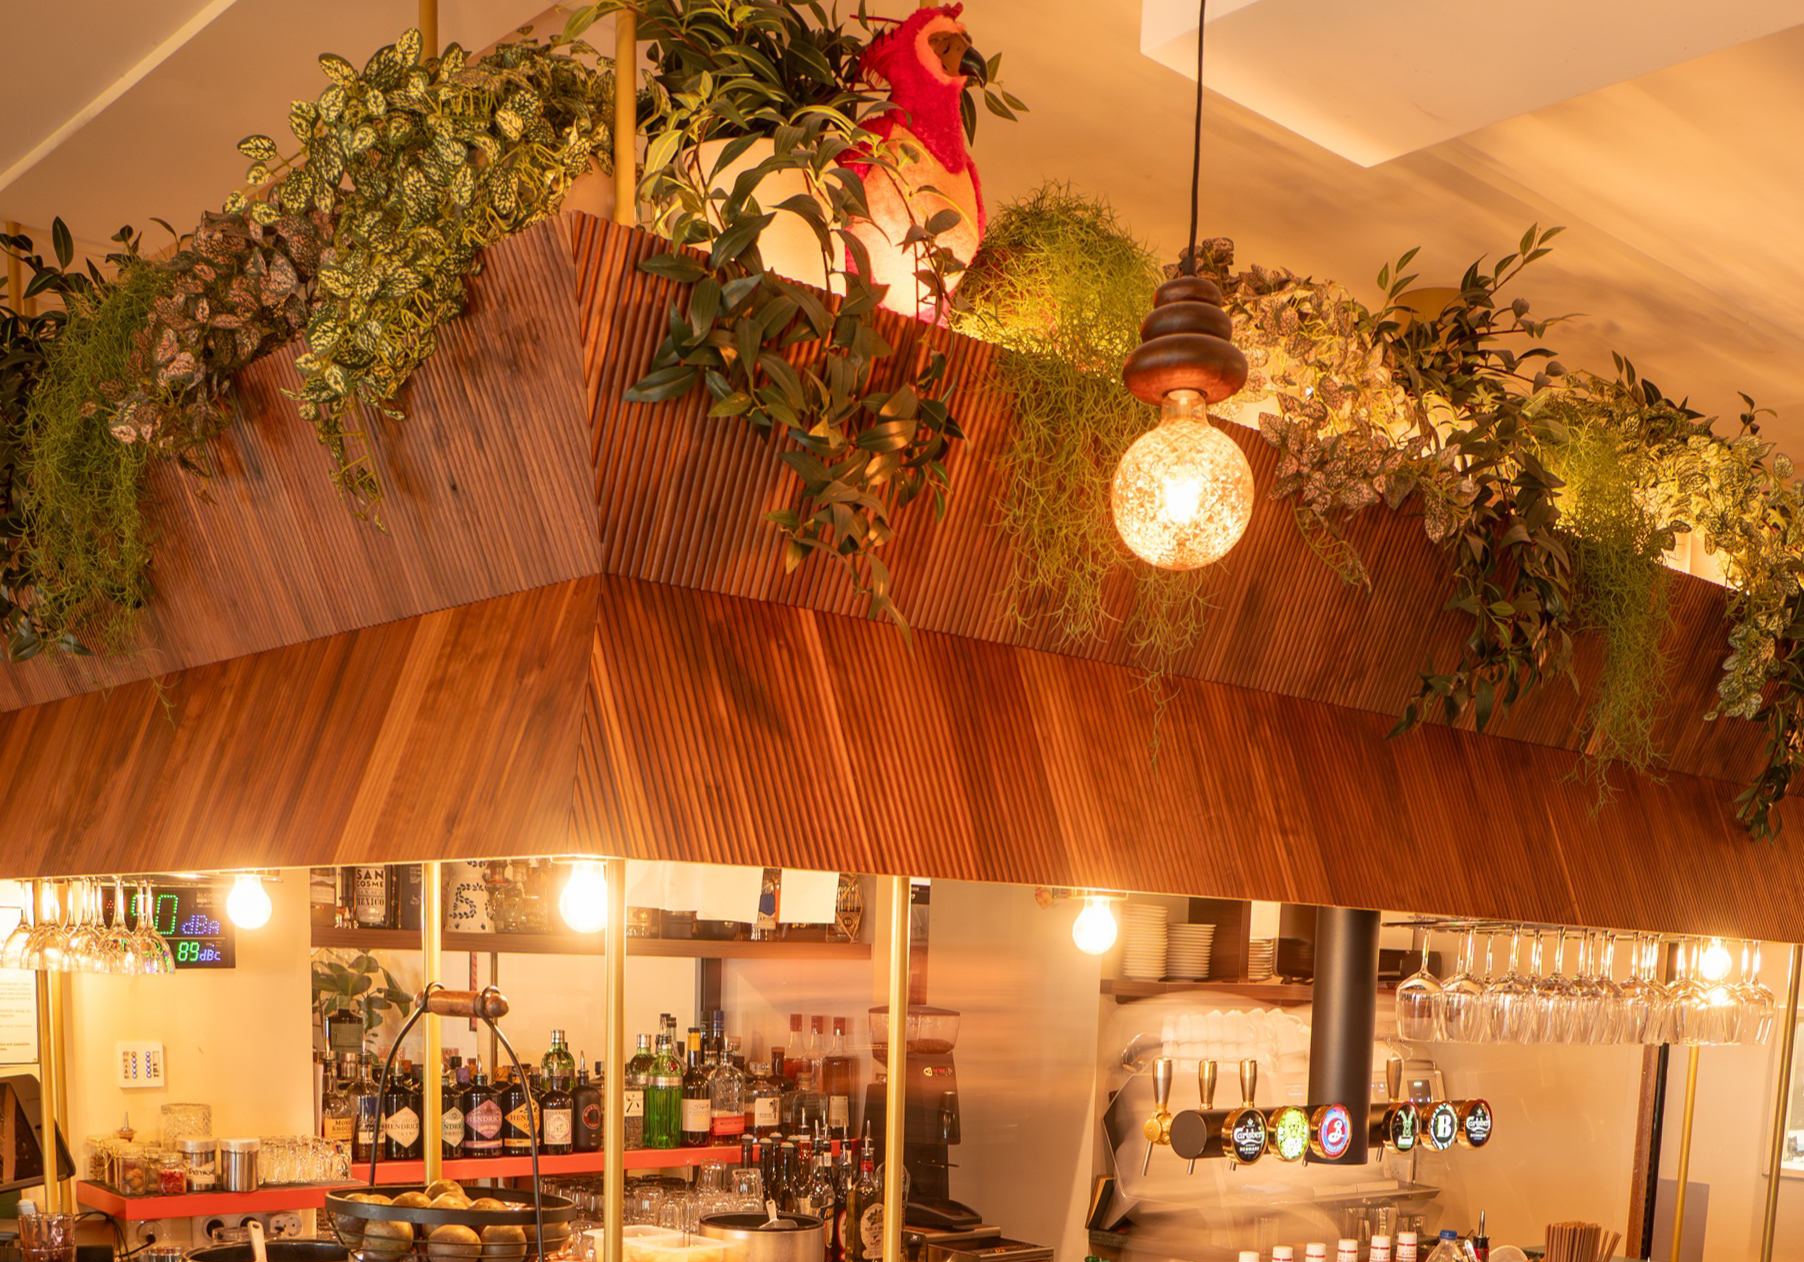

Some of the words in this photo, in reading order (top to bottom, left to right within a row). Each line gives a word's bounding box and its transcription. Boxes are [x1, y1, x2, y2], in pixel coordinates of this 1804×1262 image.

[357, 869, 384, 880] SAN
[181, 915, 220, 935] dBA
[177, 941, 200, 962] 89
[1437, 1114, 1452, 1138] B
